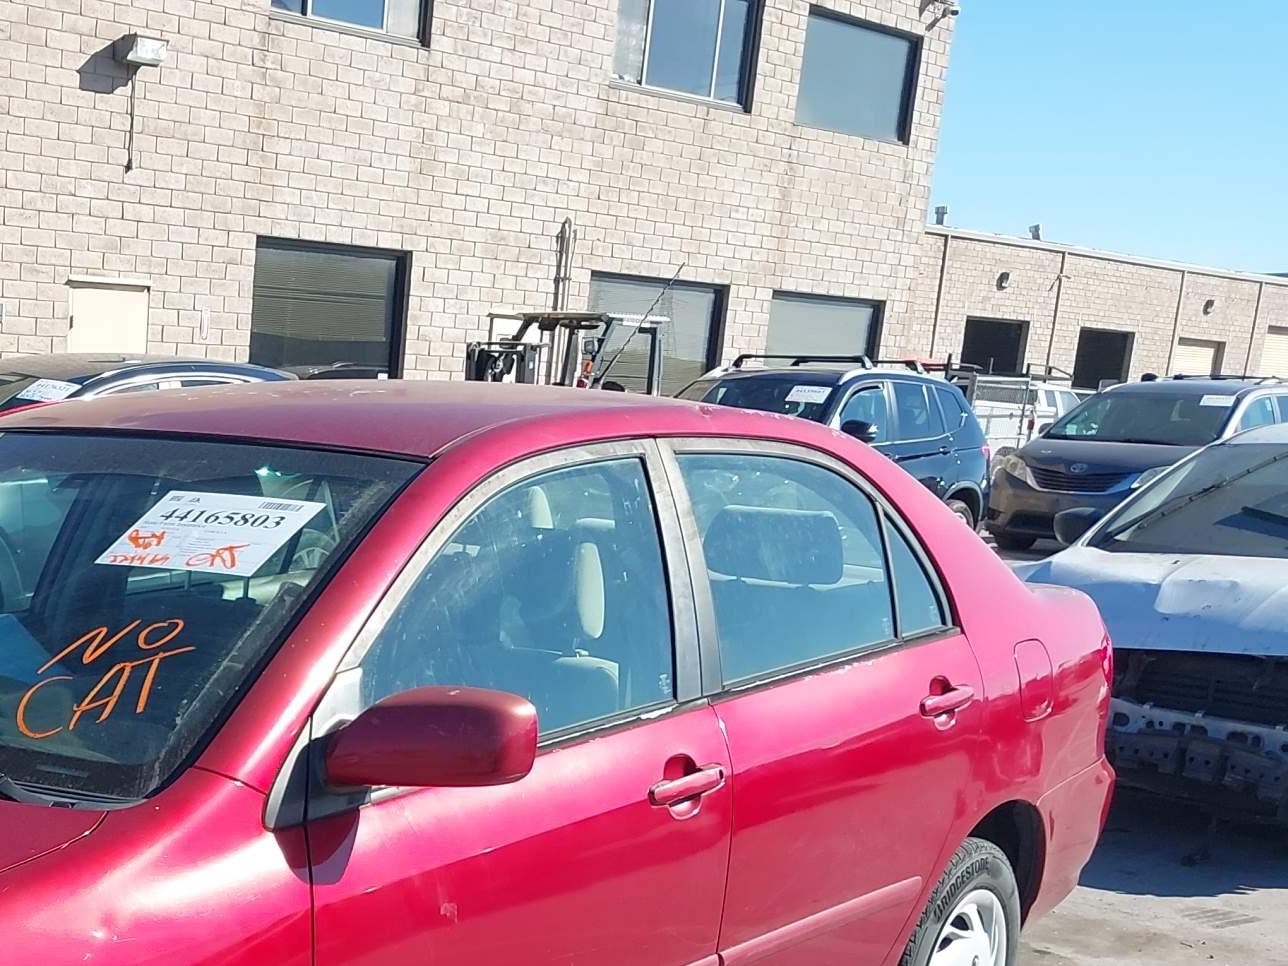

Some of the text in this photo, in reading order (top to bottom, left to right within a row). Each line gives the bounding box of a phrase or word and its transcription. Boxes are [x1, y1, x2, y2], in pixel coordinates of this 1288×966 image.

[160, 507, 286, 529] 44165803
[37, 619, 184, 674] NO
[16, 646, 197, 739] CAT
